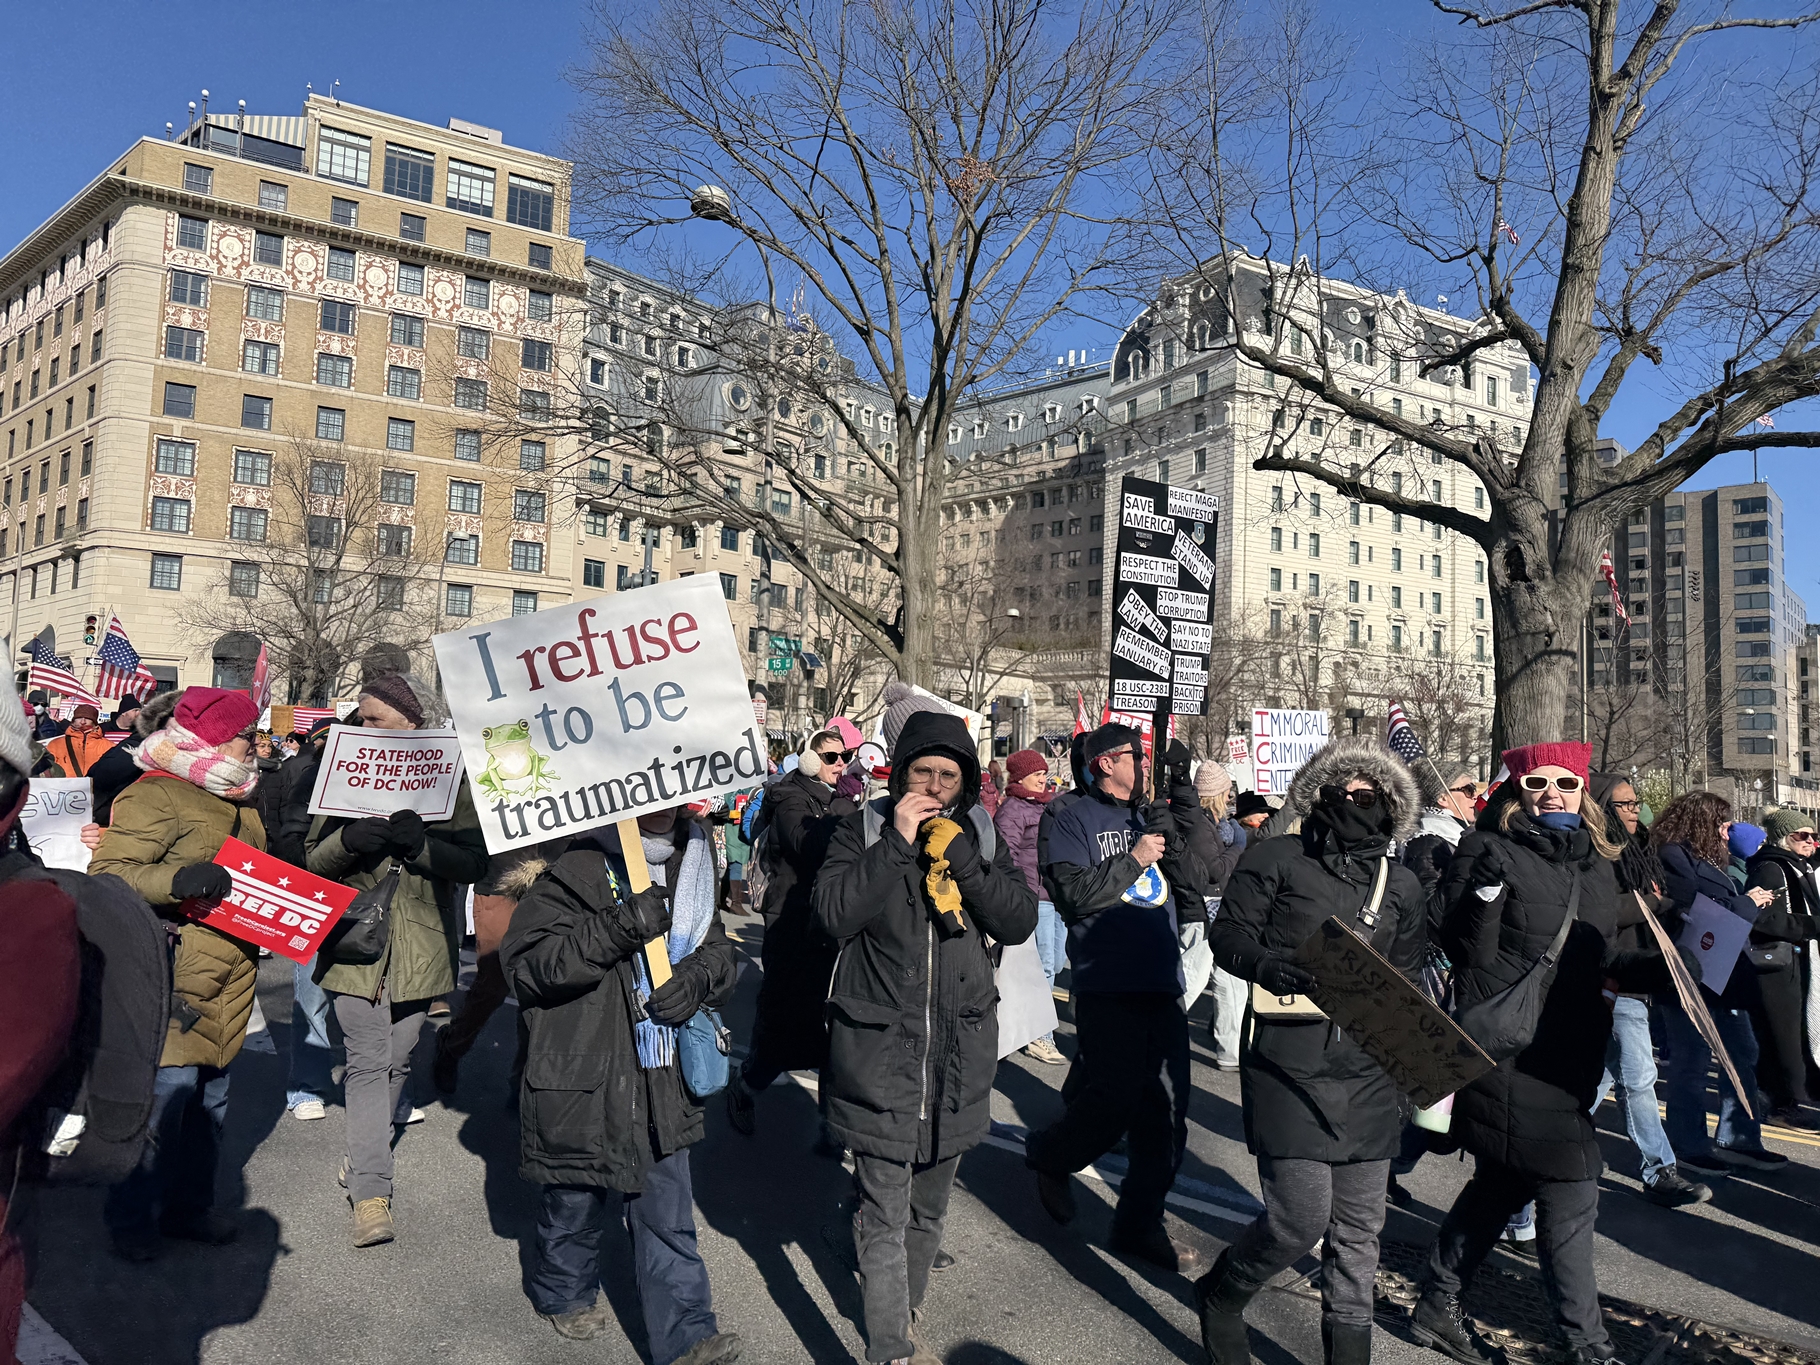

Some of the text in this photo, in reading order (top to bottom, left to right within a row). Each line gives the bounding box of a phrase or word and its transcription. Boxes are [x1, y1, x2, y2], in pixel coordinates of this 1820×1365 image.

[1125, 496, 1153, 513] SAVE
[1170, 490, 1218, 509] REJECT MAGA
[1169, 504, 1213, 522] MANIFESTO
[1124, 512, 1174, 533] AMERICA
[1178, 531, 1215, 575] VETERANS
[1122, 556, 1177, 574] RESPECT THE
[1172, 544, 1210, 585] STAND UP
[1121, 570, 1177, 586] CONSTITUTION
[1158, 590, 1208, 606] STOP TRUMP
[1119, 604, 1142, 628] LAW
[1126, 592, 1167, 640] OBEY THE
[1158, 604, 1206, 620] CORRUPTION
[1172, 624, 1210, 638] SAY NO TO
[1120, 629, 1170, 663] REMEMBER
[1172, 638, 1210, 652] NAZI STATE
[469, 608, 700, 702] I refuse
[1115, 643, 1170, 676] JANUARY 6th
[1176, 658, 1200, 669] TRUMP
[772, 659, 782, 669] 15
[1175, 671, 1207, 684] TRAITORS
[1116, 682, 1168, 694] 18 USC-2381
[1174, 686, 1204, 700] BACK TO
[1116, 697, 1156, 709] TREASON
[1174, 702, 1200, 714] PRISON
[534, 702, 594, 752] to
[608, 676, 688, 734] be
[1254, 711, 1328, 737] IMMORAL
[356, 748, 444, 762] STATEHOOD
[1231, 745, 1244, 754] FREE
[336, 760, 454, 777] FOR THE PEOPLE
[348, 776, 438, 792] OF DC NOW!
[491, 728, 765, 841] traumatized
[223, 888, 280, 919] REE
[279, 910, 321, 935] DC
[1340, 948, 1397, 999] RISE
[1418, 1016, 1446, 1042] UP
